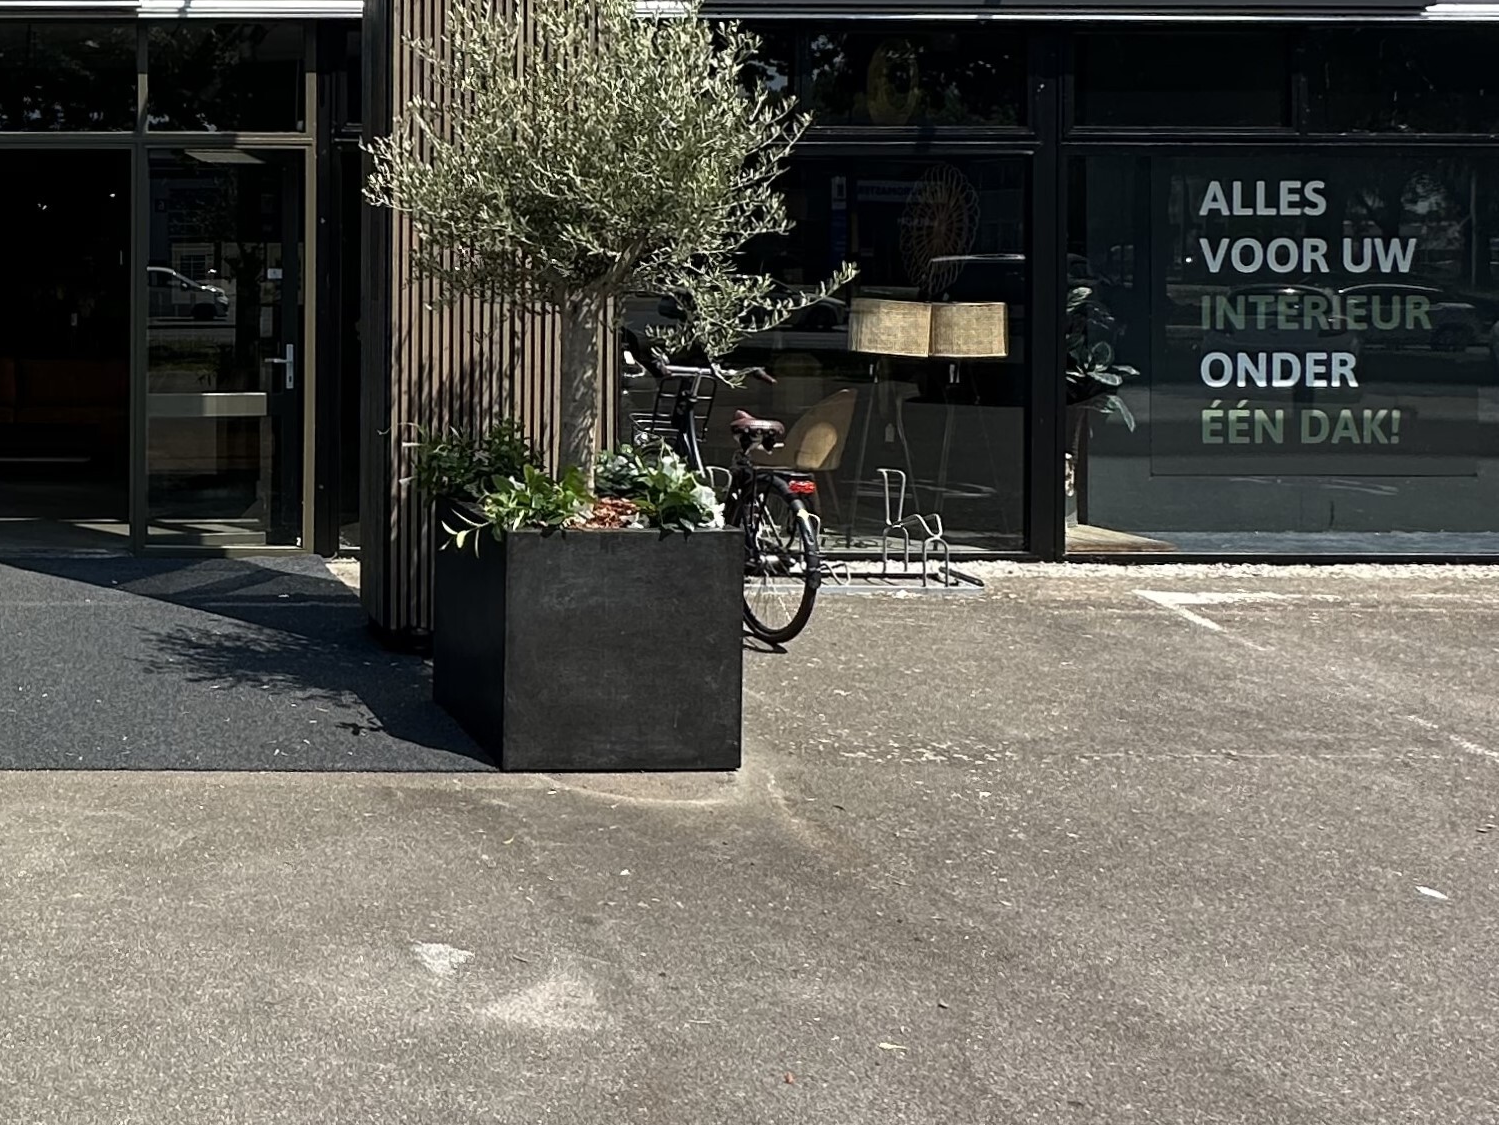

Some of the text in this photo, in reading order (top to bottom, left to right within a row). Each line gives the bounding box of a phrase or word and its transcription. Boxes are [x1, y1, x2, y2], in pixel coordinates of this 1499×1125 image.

[1199, 179, 1326, 216] ALLES
[1199, 237, 1417, 273] VOOR UW
[1201, 294, 1432, 331] INTERIEUR
[1200, 351, 1359, 388] ONDER
[1201, 399, 1402, 445] ÉÉN DAK!
